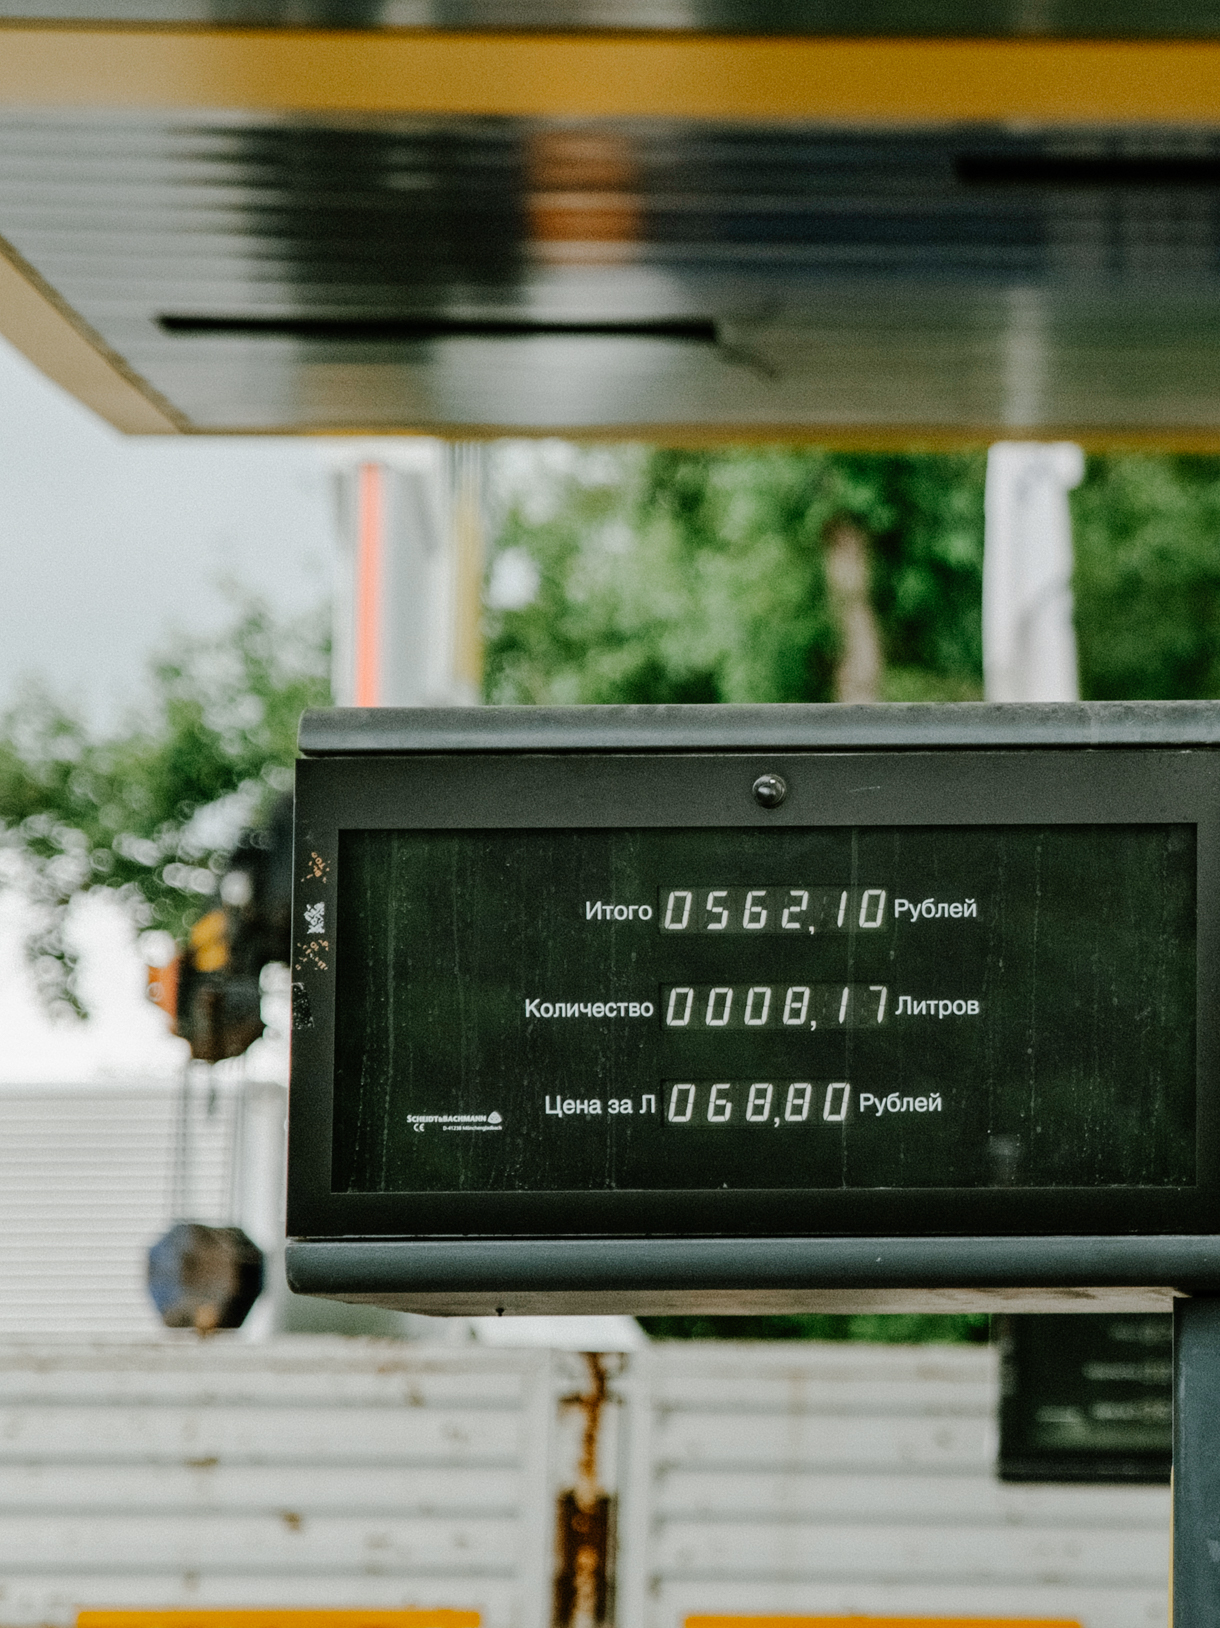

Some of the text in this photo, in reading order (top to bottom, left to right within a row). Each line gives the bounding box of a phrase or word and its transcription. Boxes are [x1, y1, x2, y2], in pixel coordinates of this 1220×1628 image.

[585, 888, 978, 935] Итого 0562,10 Рублей
[525, 985, 980, 1032] Количество 0008,17 Литров
[545, 1082, 943, 1128] Цена за Л 068,80 Рублей
